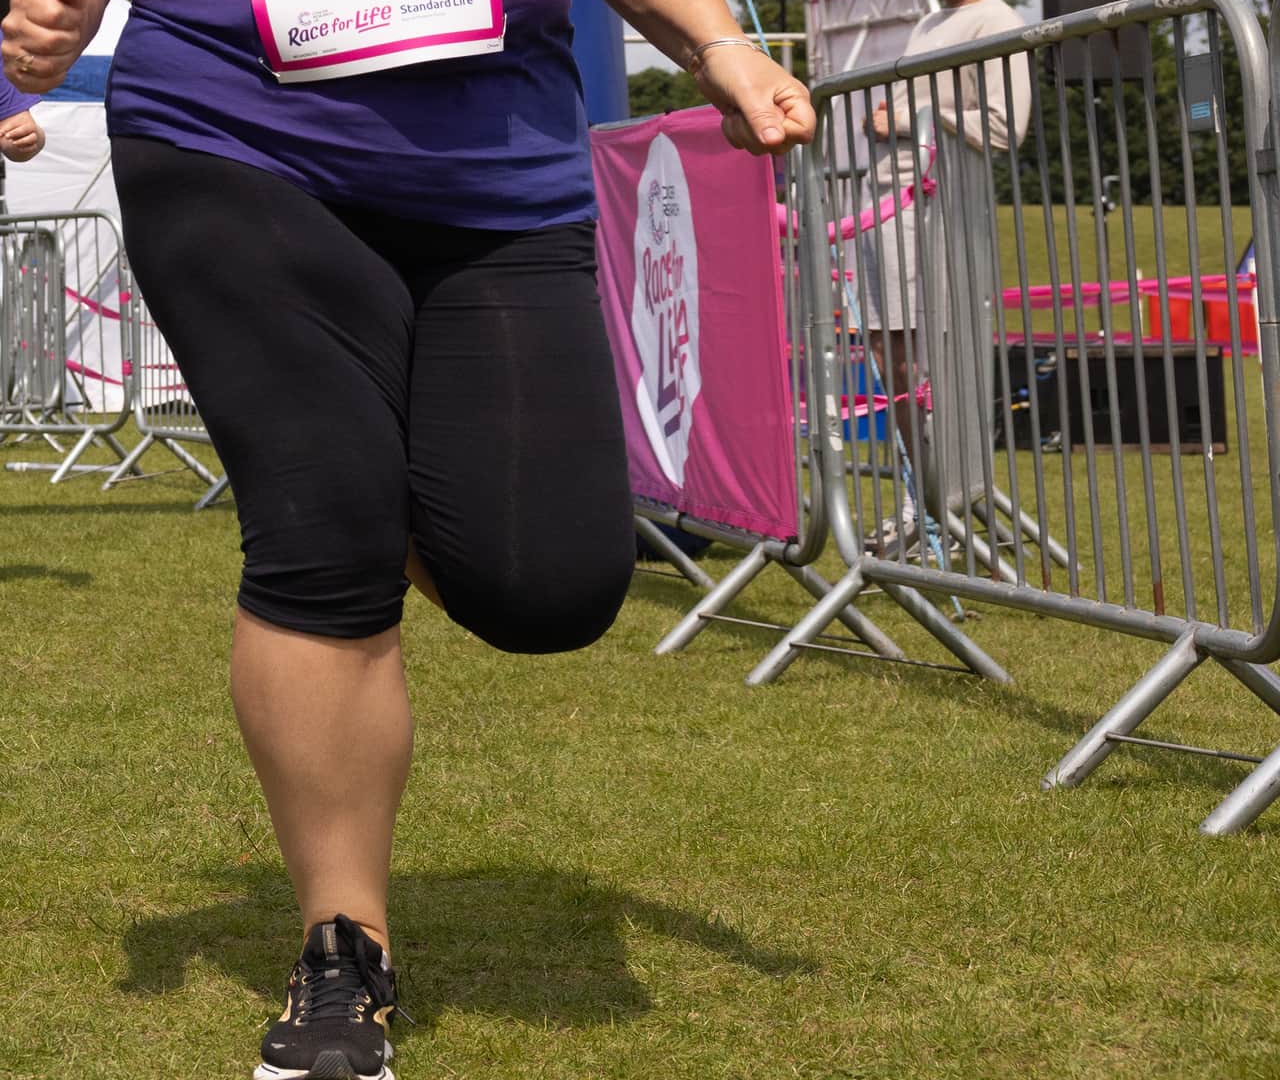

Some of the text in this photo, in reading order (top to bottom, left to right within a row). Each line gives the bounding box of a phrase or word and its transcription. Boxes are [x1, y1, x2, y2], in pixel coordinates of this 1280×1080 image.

[288, 22, 329, 47] Race
[332, 17, 353, 33] for
[355, 5, 392, 29] Life
